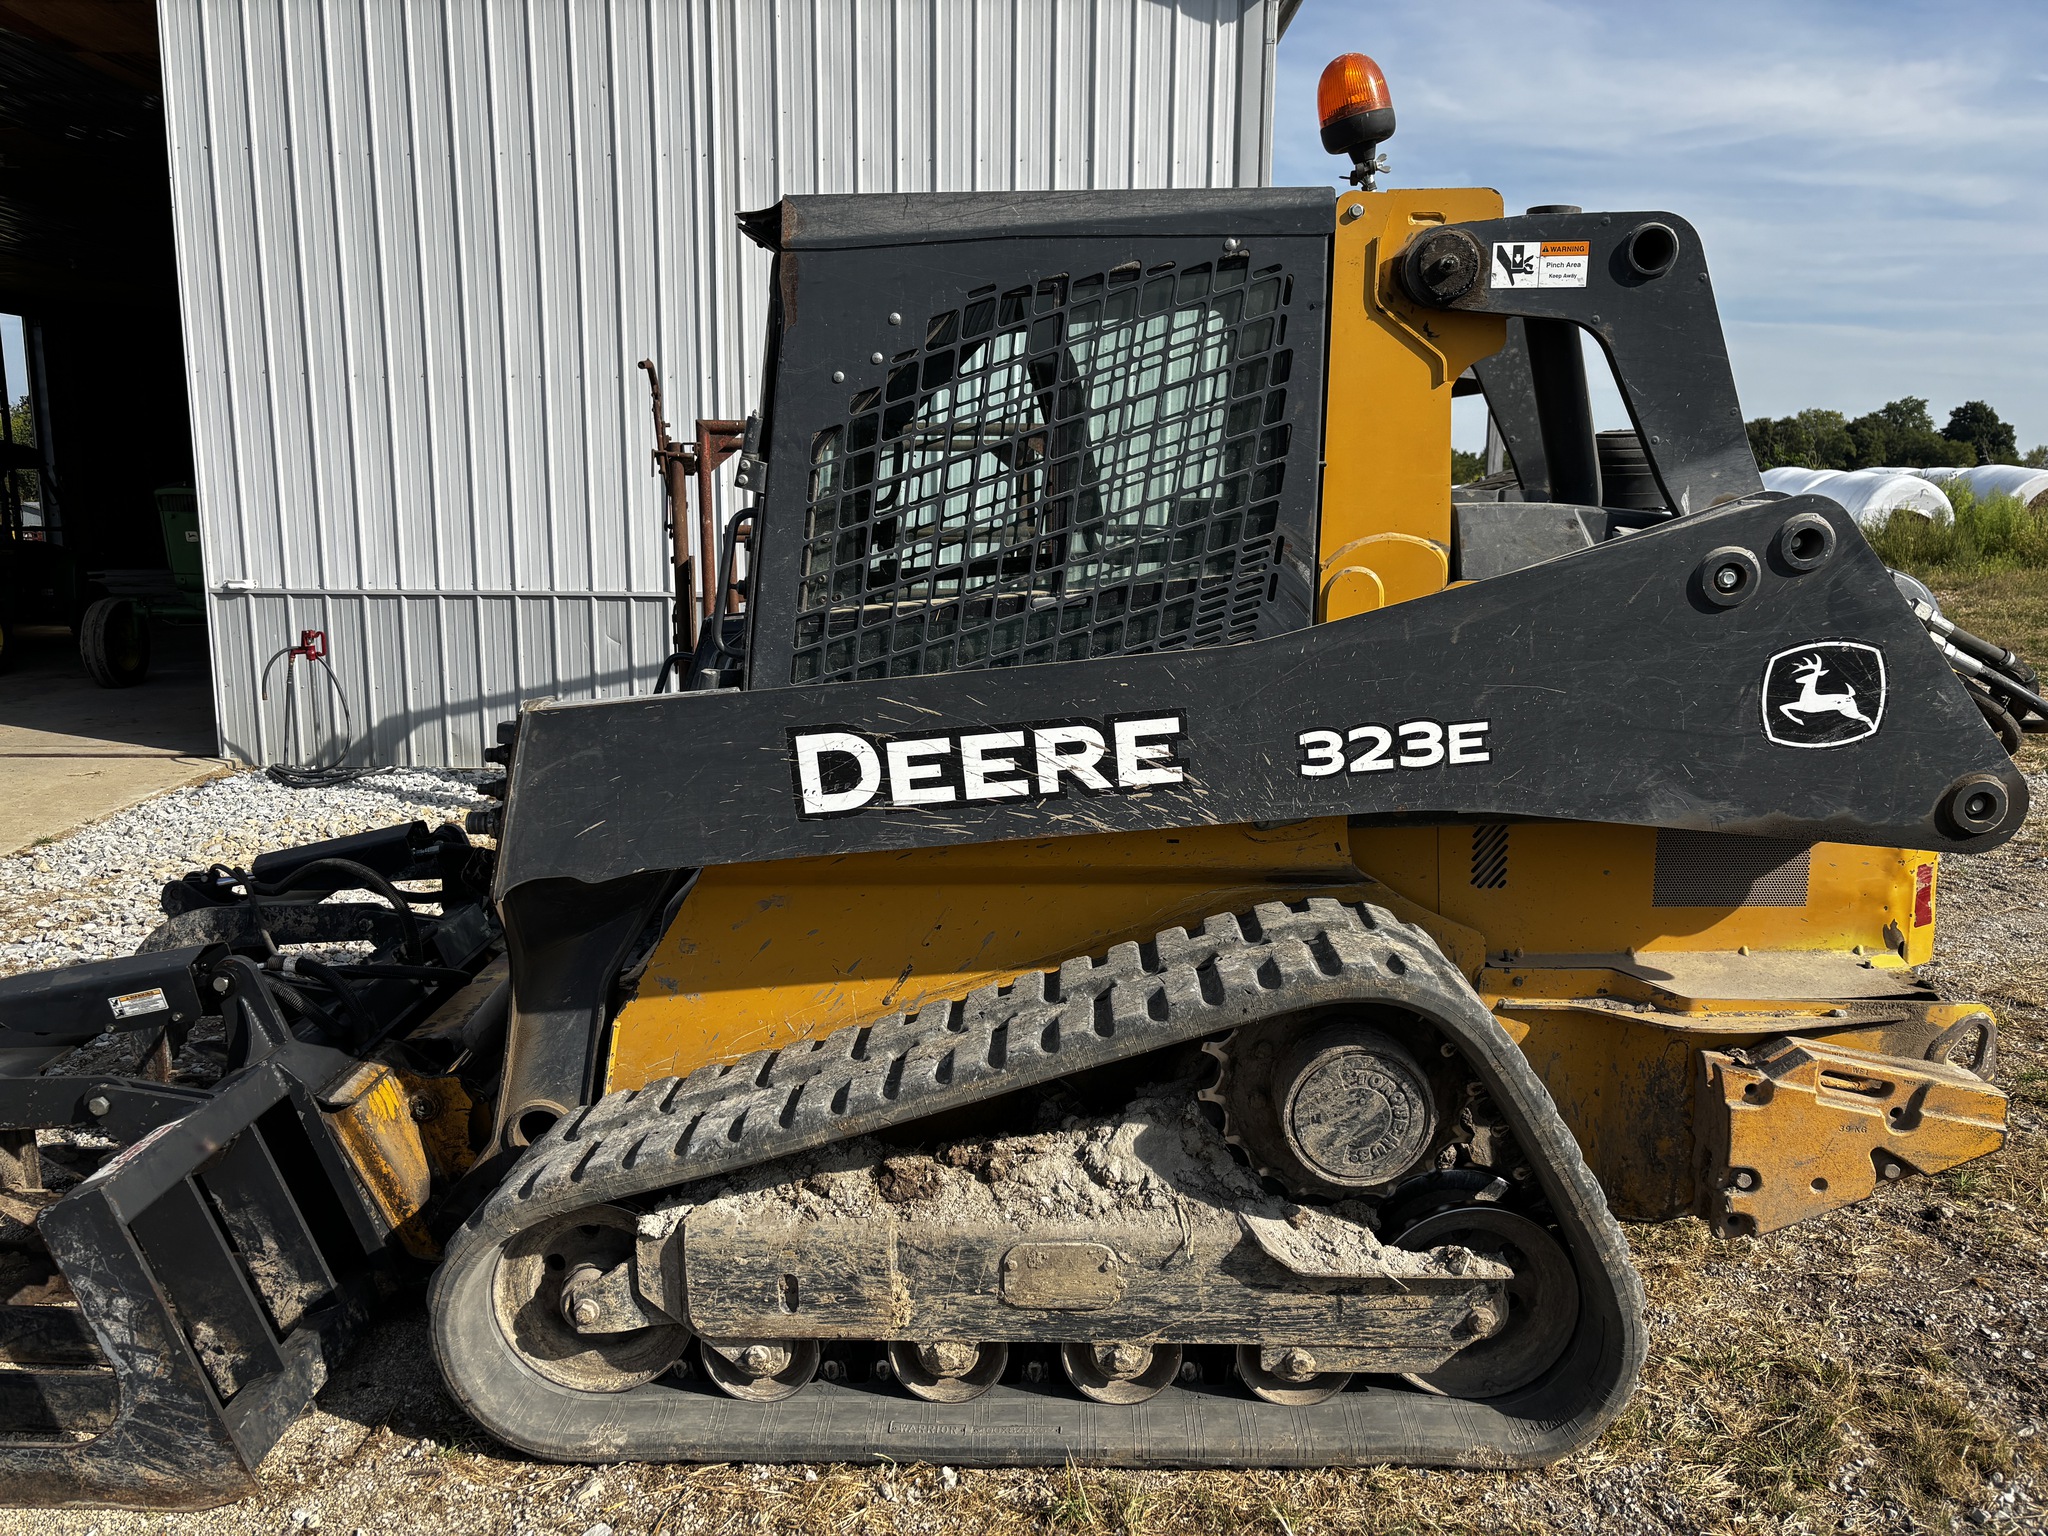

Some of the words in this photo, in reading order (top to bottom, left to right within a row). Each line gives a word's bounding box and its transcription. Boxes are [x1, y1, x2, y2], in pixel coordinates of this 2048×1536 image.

[795, 716, 1184, 814] DEERE
[1299, 721, 1490, 777] 323E
[900, 1423, 959, 1435] WARRIOR
